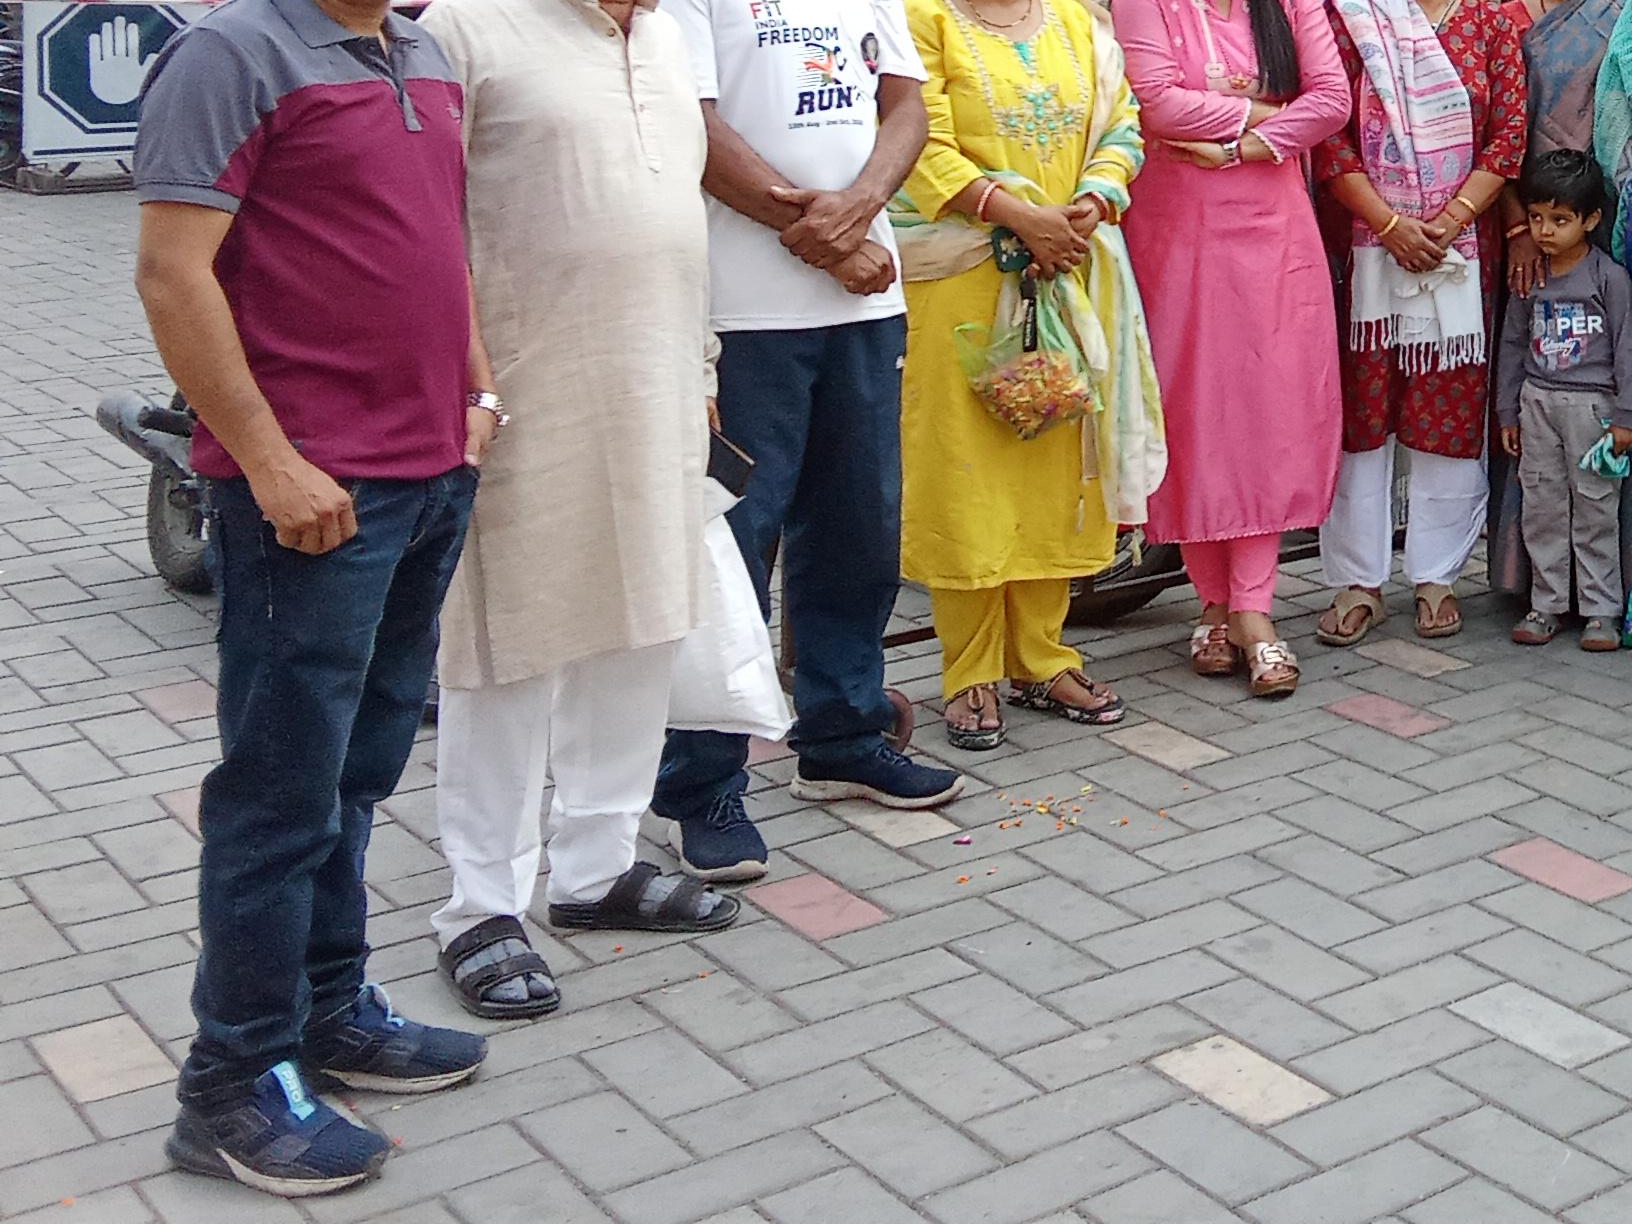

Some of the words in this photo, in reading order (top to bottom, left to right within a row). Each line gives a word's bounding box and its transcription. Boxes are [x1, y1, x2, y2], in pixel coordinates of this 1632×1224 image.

[756, 19, 788, 30] INDIA
[758, 26, 839, 48] FREEDOM
[795, 87, 853, 116] RUN
